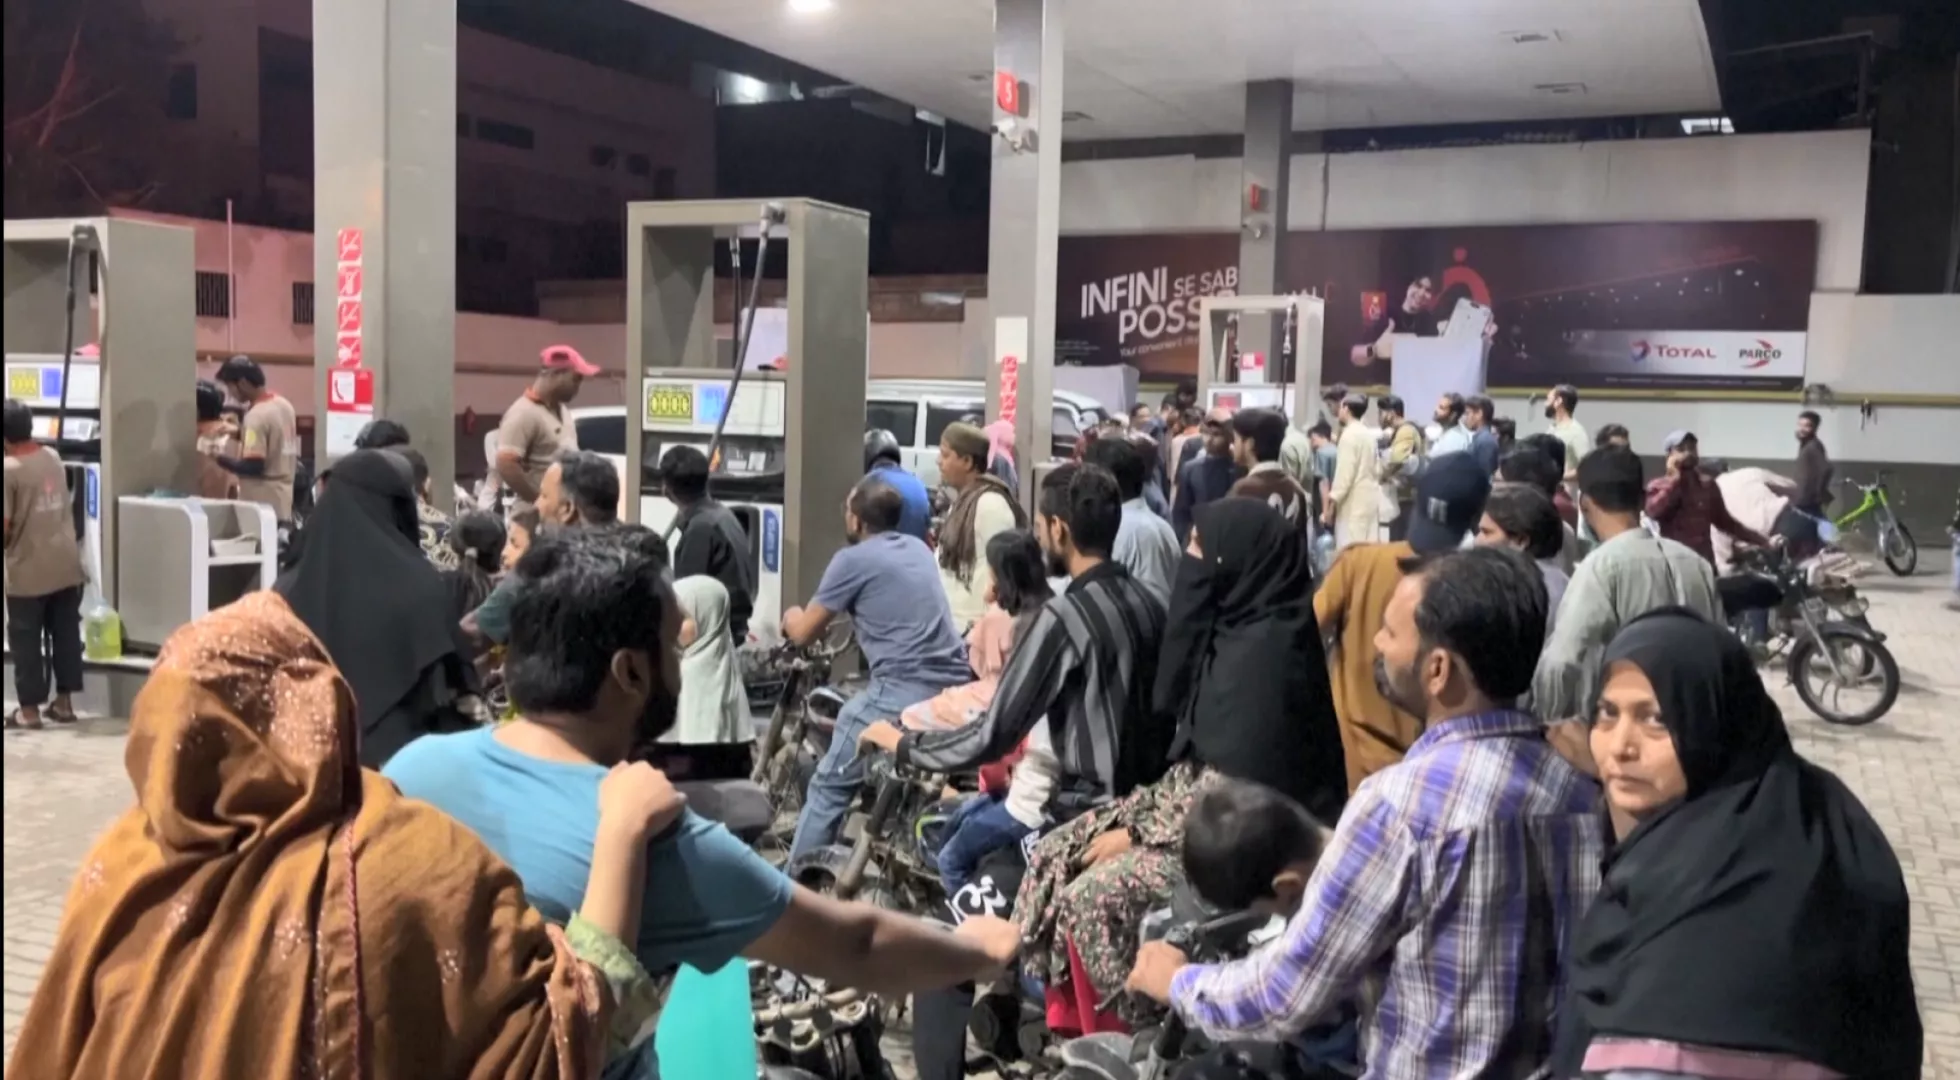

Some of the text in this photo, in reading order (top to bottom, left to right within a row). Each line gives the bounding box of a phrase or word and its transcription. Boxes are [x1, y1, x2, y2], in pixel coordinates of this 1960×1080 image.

[1080, 266, 1238, 319] INFINI SE SAB
[1119, 291, 1236, 345] POSS
[1655, 344, 1782, 359] TOTAL PARCO
